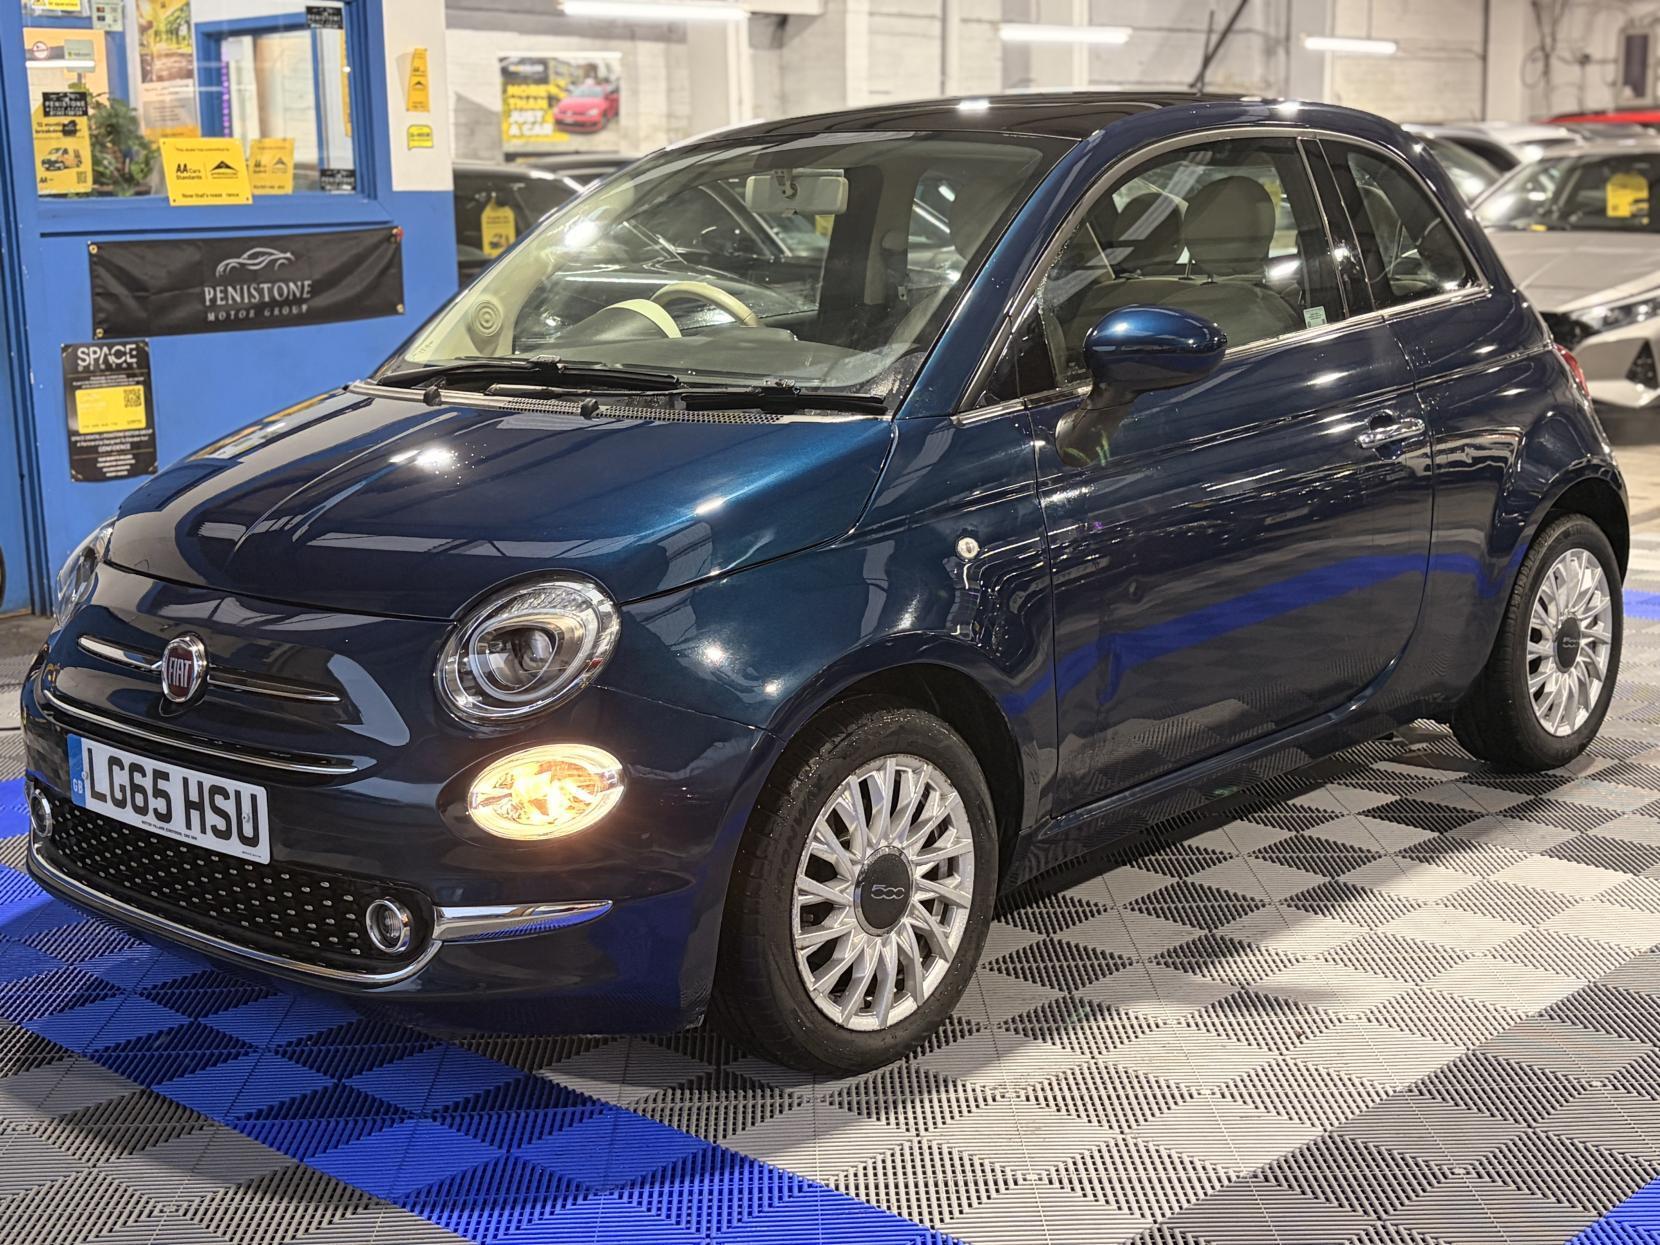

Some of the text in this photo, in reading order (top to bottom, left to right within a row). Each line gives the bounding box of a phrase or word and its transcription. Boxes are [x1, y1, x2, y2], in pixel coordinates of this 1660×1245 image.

[176, 163, 189, 173] AA
[204, 280, 312, 306] PENISTONE
[207, 304, 308, 322] MOTOR GROUP
[77, 344, 137, 366] SPACE
[169, 657, 192, 687] FIAT
[73, 778, 83, 794] GB
[87, 747, 260, 848] LG65 HSU
[871, 884, 905, 899] 500
